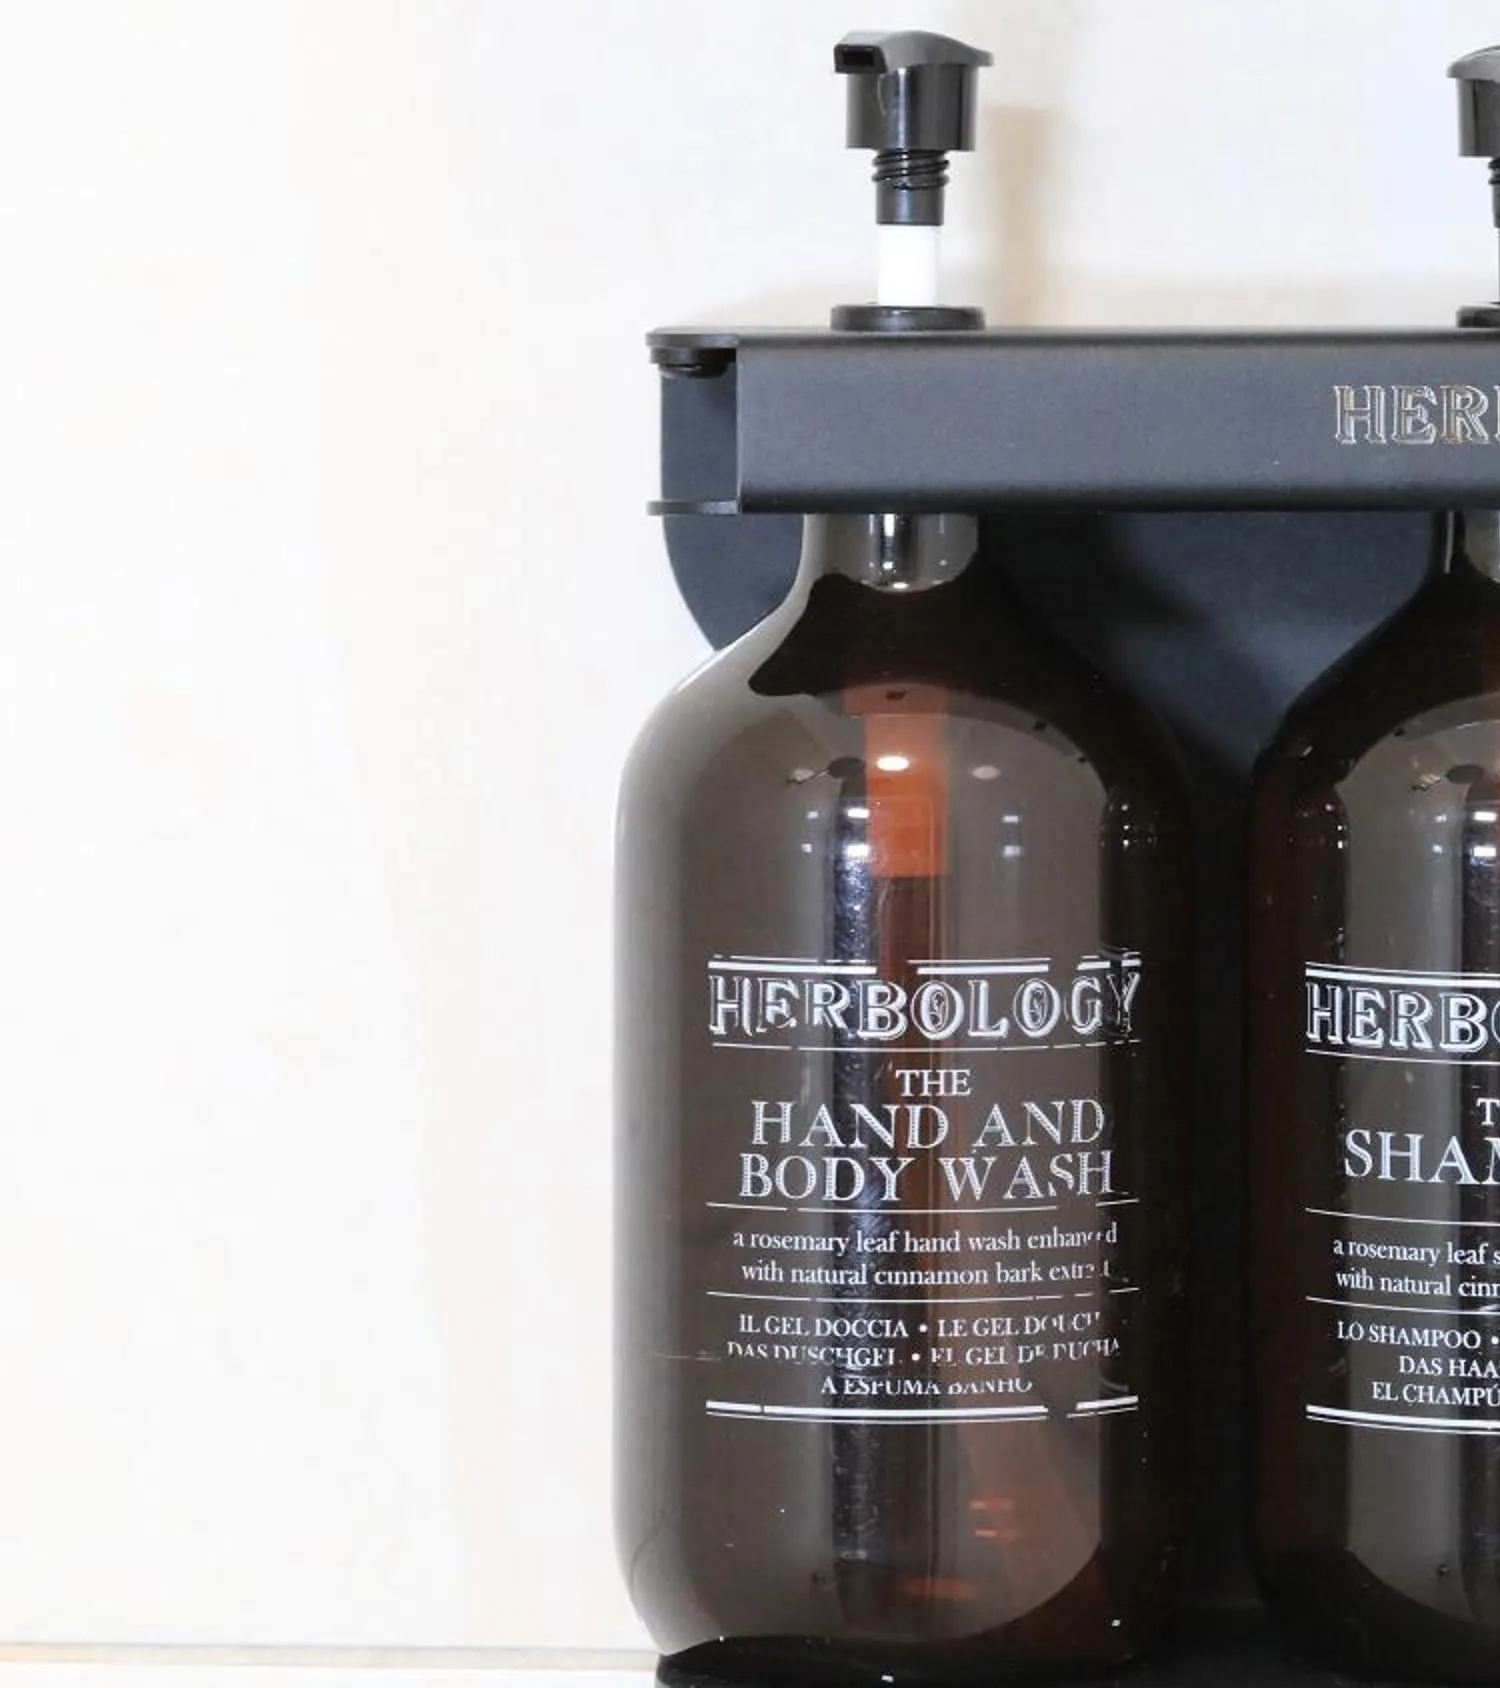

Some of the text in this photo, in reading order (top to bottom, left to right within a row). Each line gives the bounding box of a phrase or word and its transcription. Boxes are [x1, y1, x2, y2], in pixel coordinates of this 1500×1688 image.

[708, 972, 1140, 1040] HERBOLOGY
[895, 1069, 970, 1096] THE
[751, 1099, 1105, 1148] HAND AND
[739, 1150, 1116, 1200] BODY WASH
[733, 1232, 744, 1246] a
[751, 1232, 847, 1257] rosemary
[856, 1231, 898, 1253] leaf
[904, 1232, 960, 1253] hand
[968, 1230, 1021, 1252] wash
[1333, 1240, 1343, 1255] a
[1349, 1241, 1441, 1267] rosemary
[1447, 1243, 1488, 1264] leaf
[742, 1259, 783, 1282] with
[791, 1263, 866, 1284] natural
[874, 1266, 988, 1286] cinnamon
[997, 1261, 1043, 1284] bark
[1336, 1267, 1373, 1290] with
[1380, 1272, 1451, 1296] natural
[739, 1314, 760, 1332] IL
[766, 1317, 809, 1335] GEL
[815, 1319, 909, 1338] DOCCIA
[939, 1319, 967, 1337] LE
[973, 1317, 1020, 1335] GEL
[1338, 1321, 1363, 1341] LO
[1369, 1324, 1482, 1348] SHAMPOO
[727, 1341, 769, 1362] DAS
[966, 1347, 1008, 1365] GEL
[1399, 1356, 1441, 1376] DAS
[820, 1377, 837, 1395] A
[1372, 1381, 1398, 1402] EL
